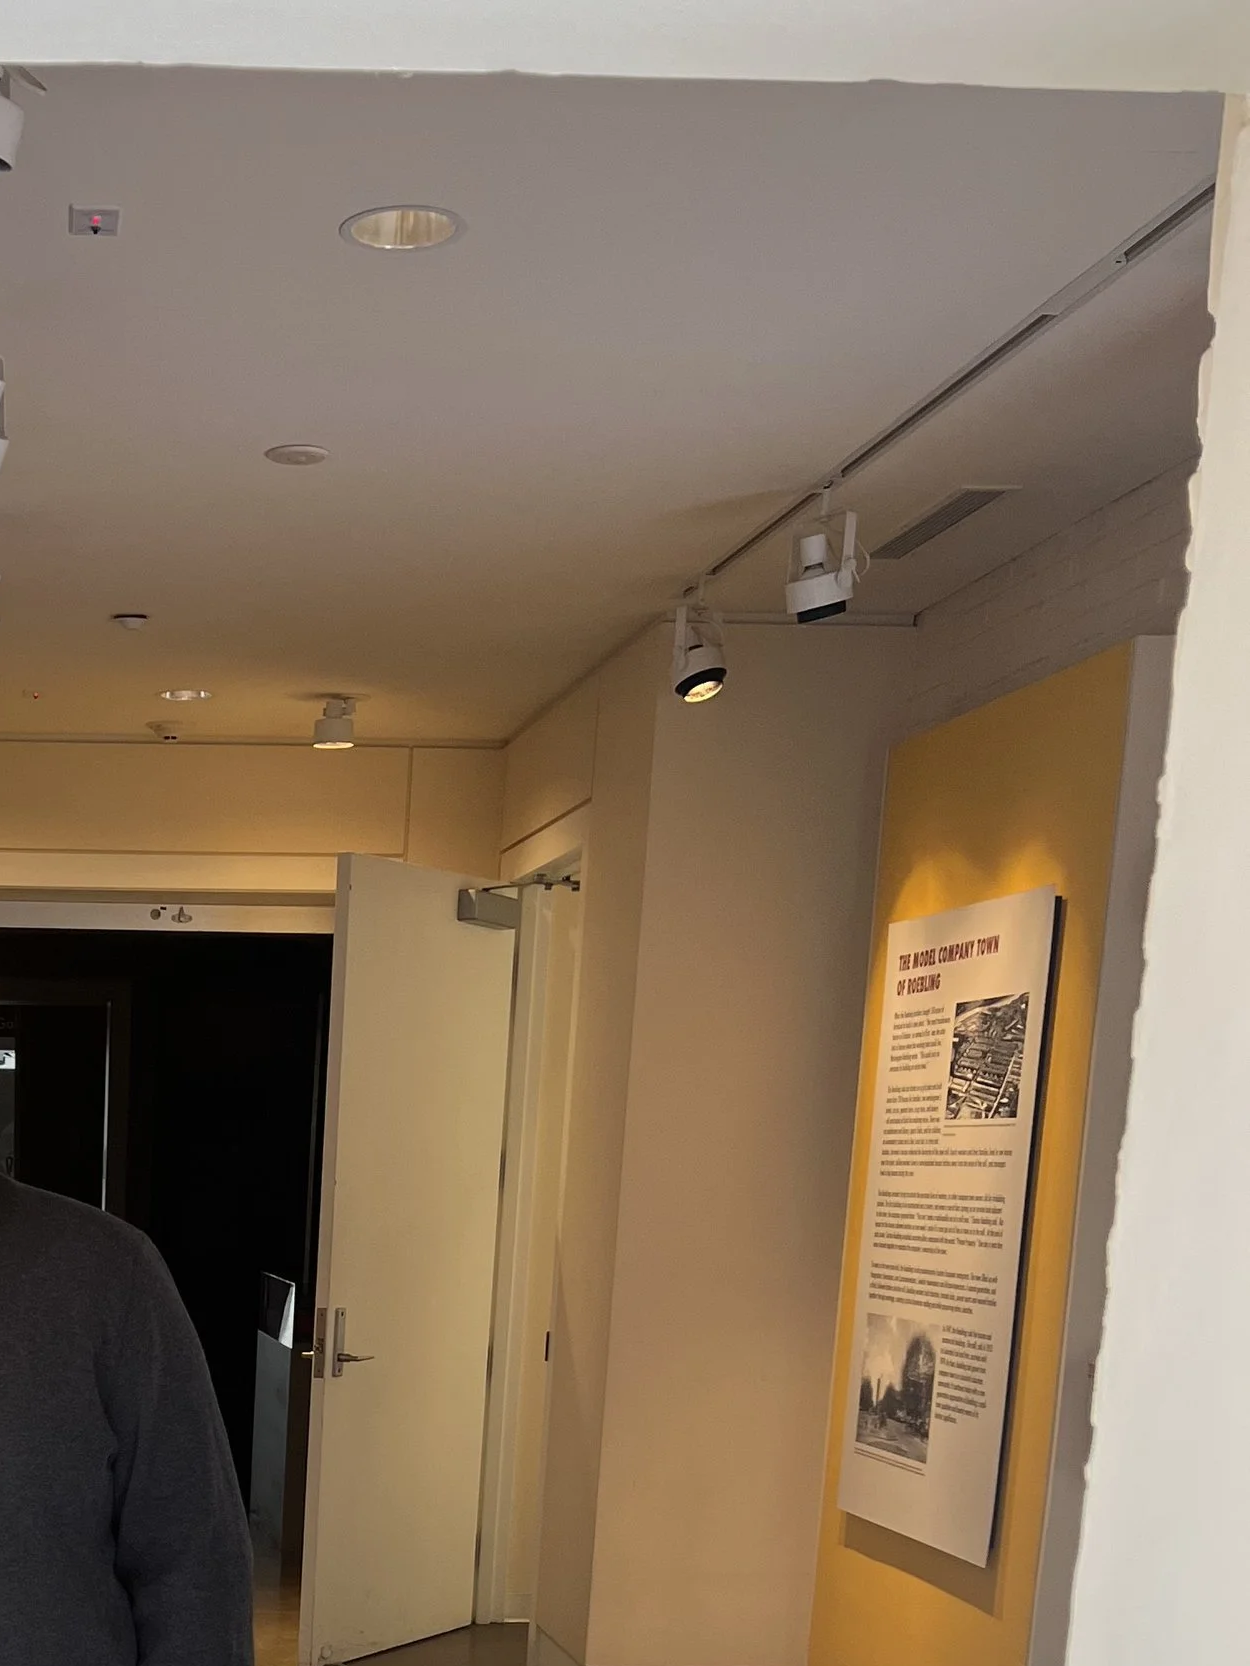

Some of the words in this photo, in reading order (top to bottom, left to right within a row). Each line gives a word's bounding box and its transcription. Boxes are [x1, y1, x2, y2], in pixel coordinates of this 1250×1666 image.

[899, 953, 911, 971] THE
[912, 948, 936, 969] MODEL
[938, 939, 975, 963] COMPANY
[976, 935, 1000, 957] TOWN
[897, 980, 906, 997] OF
[908, 974, 941, 995] ROEBLING
